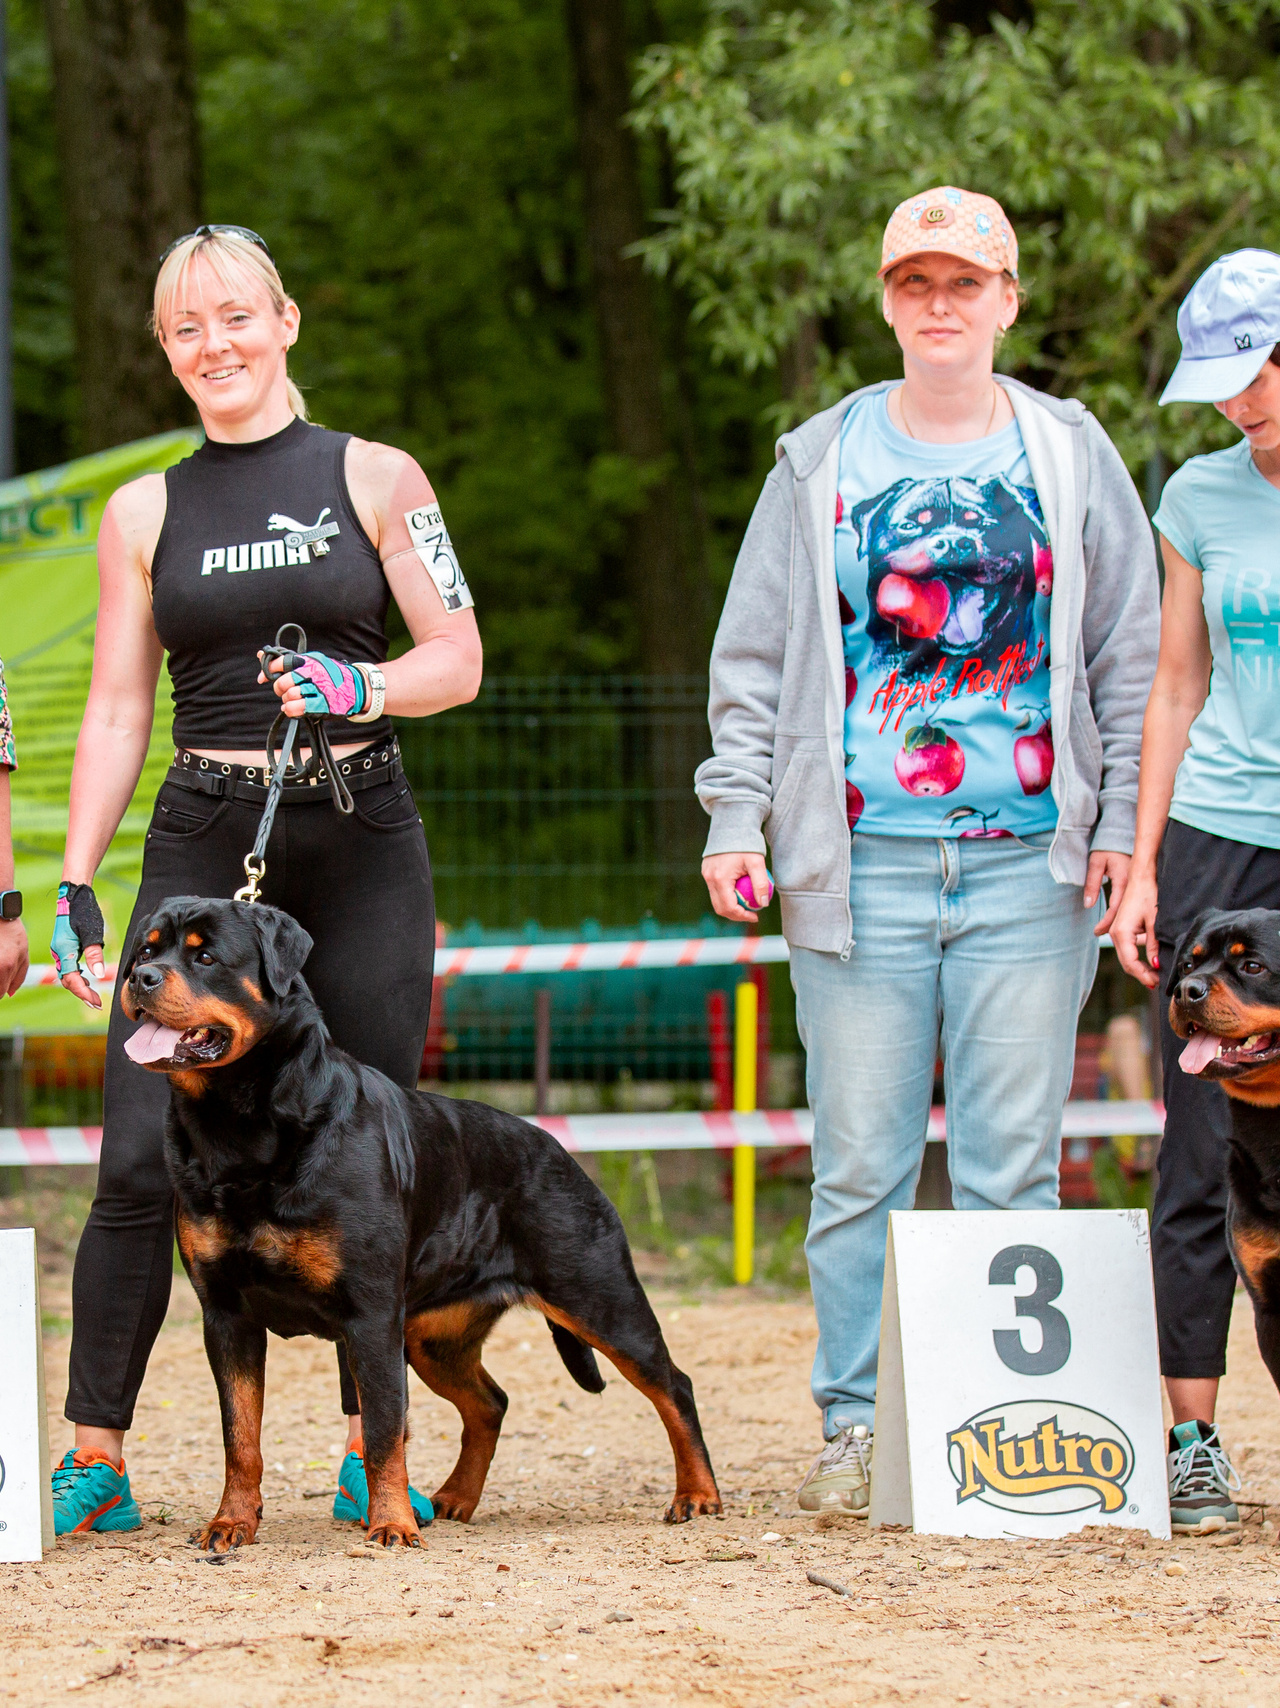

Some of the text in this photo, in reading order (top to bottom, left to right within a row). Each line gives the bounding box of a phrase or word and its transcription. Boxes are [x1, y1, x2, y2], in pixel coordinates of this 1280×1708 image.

[411, 508, 442, 530] Ста
[200, 539, 312, 577] PUMA
[1232, 566, 1280, 616] R
[868, 656, 947, 735] Apple
[1235, 654, 1280, 693] NI
[988, 1244, 1071, 1376] 3
[946, 1415, 1128, 1513] Nutro
